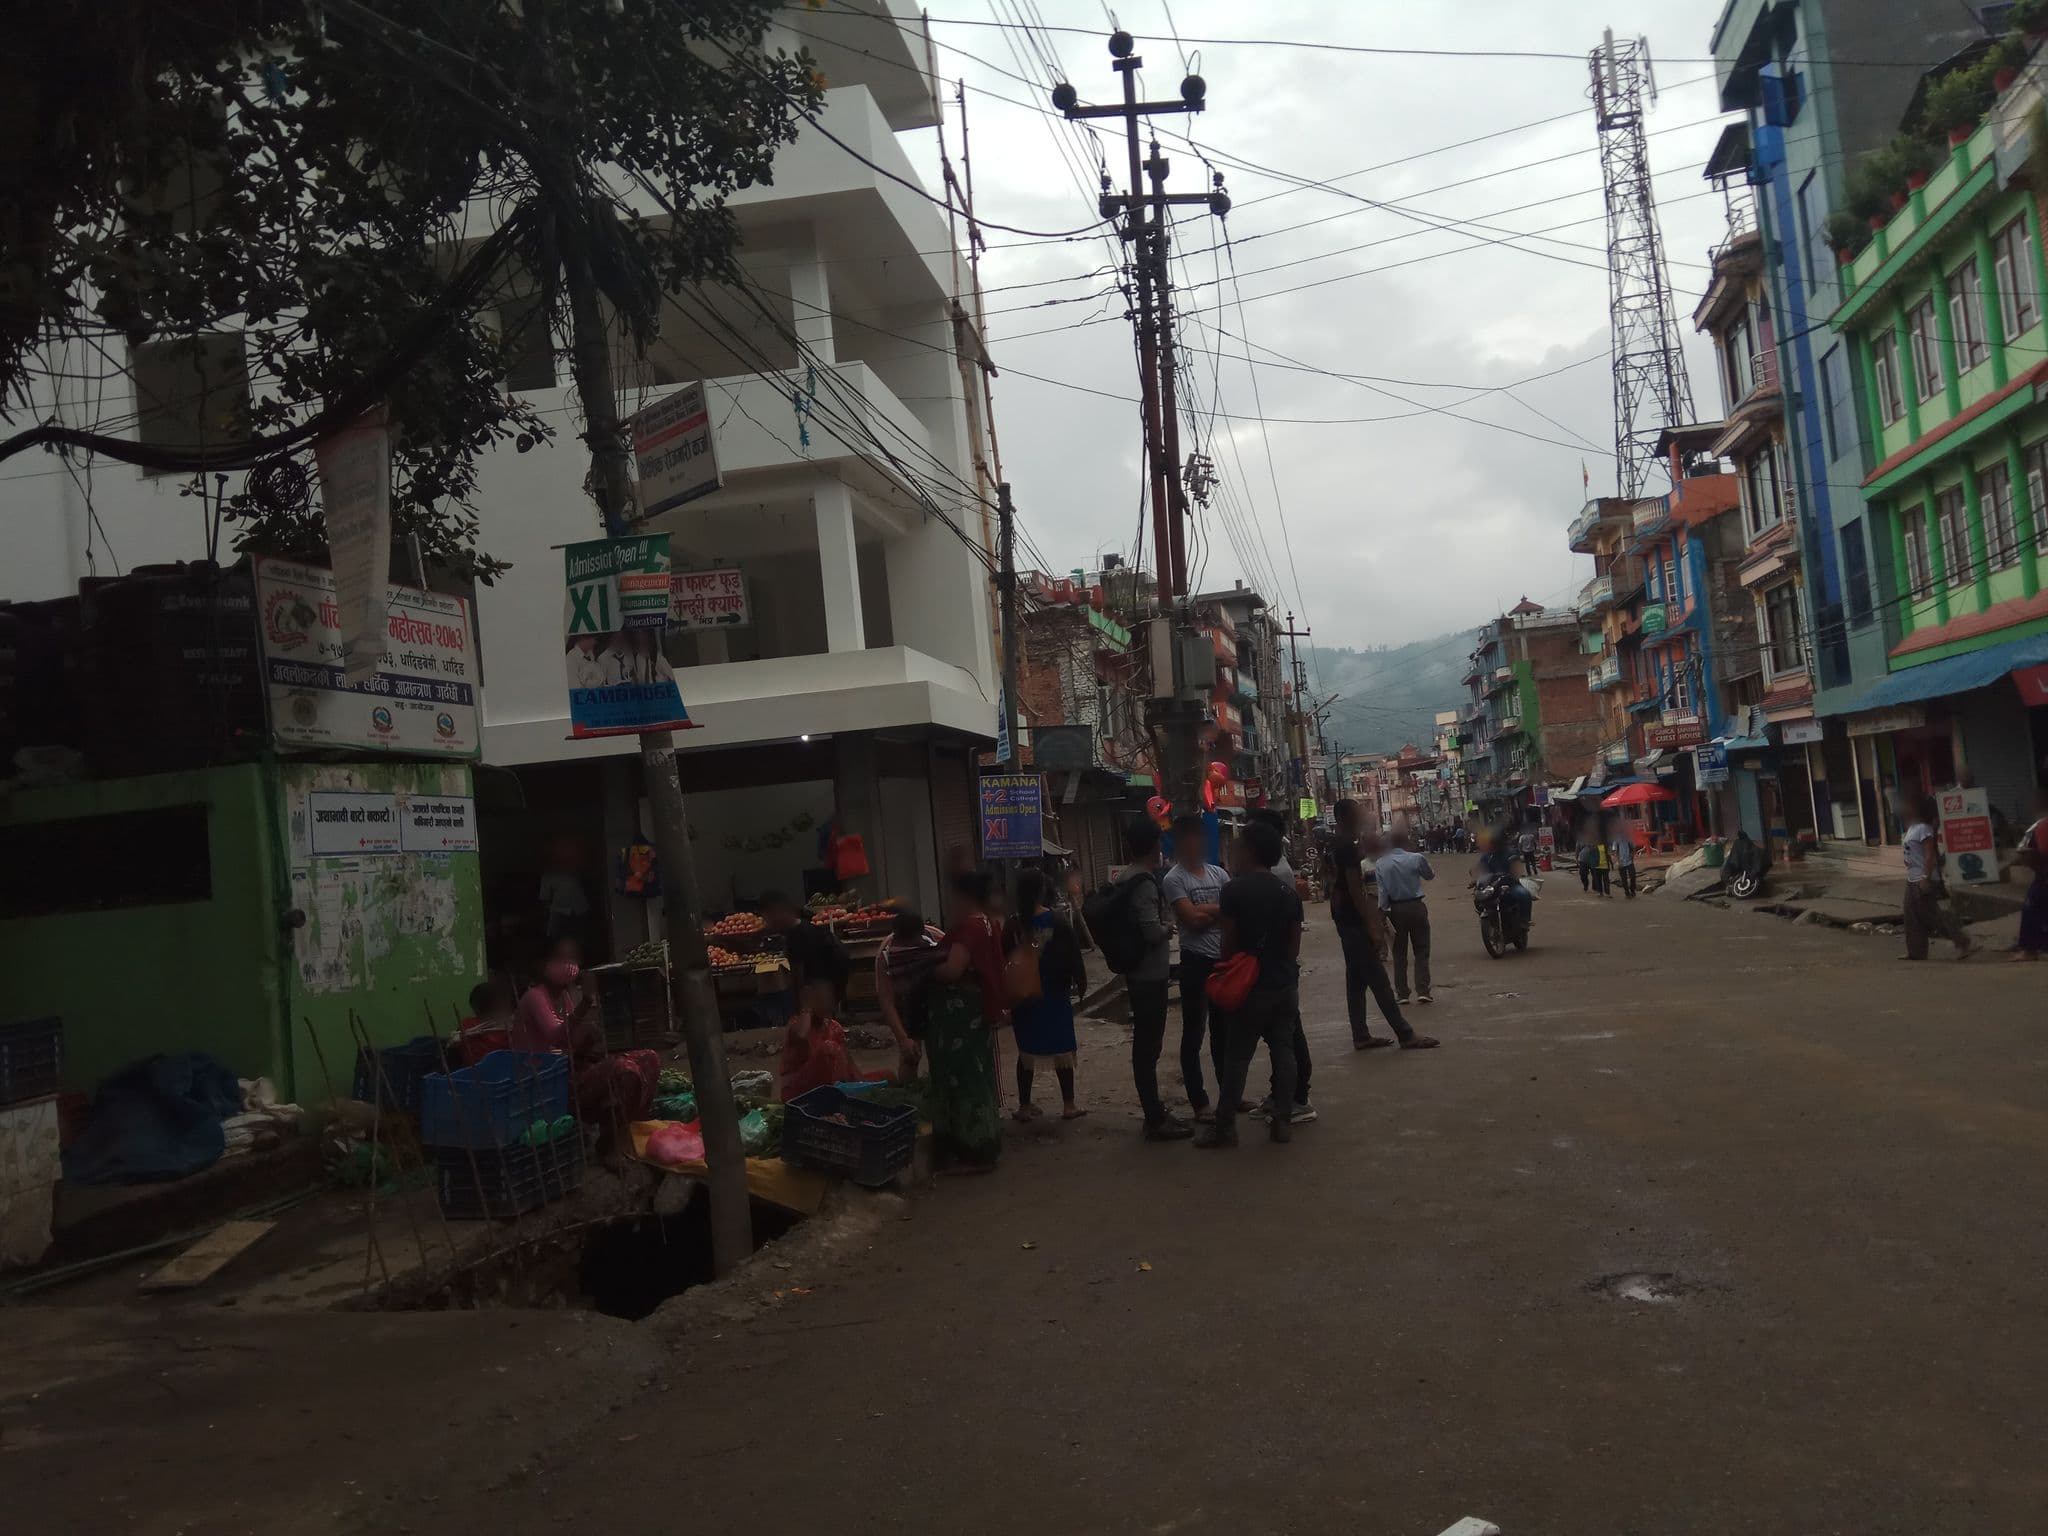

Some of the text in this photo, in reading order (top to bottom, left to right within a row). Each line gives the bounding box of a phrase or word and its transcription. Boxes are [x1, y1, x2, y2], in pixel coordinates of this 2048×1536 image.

[569, 539, 649, 580] Admission Open !!!
[623, 577, 668, 589] nagement
[568, 583, 610, 633] XI
[624, 598, 667, 608] manities
[626, 615, 664, 627] ducation
[982, 777, 1038, 788] KAMANA
[985, 818, 1008, 841] XI
